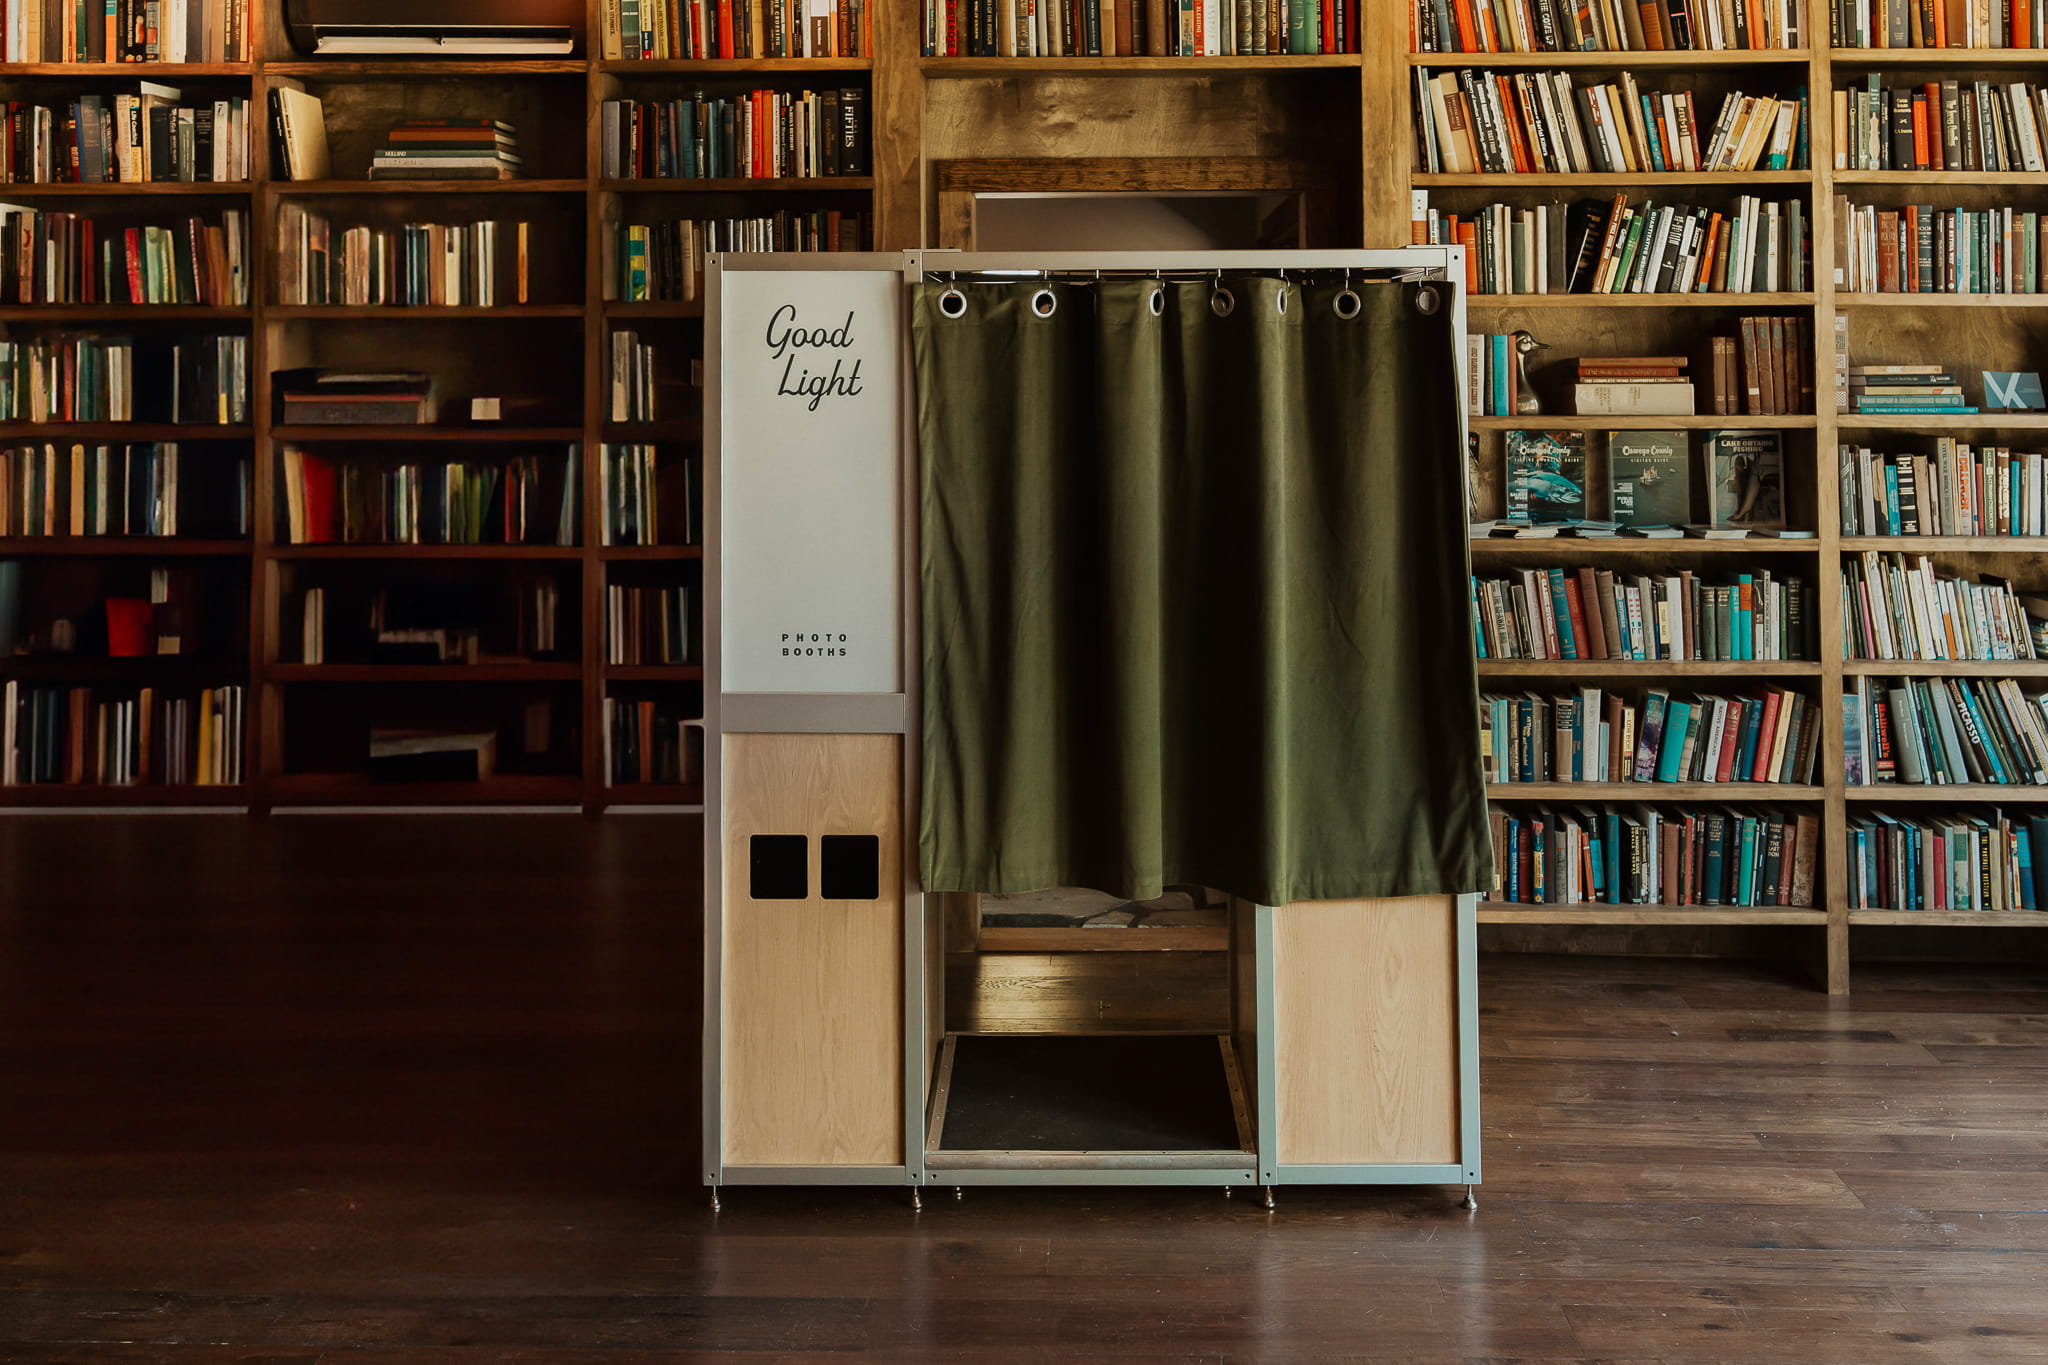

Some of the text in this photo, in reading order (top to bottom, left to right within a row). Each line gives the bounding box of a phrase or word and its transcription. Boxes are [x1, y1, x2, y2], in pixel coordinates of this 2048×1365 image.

[1539, 0, 1548, 12] THE
[1542, 13, 1551, 34] COME
[947, 26, 955, 49] ROSE
[1466, 77, 1474, 93] Century
[844, 106, 854, 147] FIFTIES
[1535, 119, 1544, 137] Serial
[1539, 137, 1548, 156] Killers
[1637, 211, 1656, 280] QUANTITATIVE MEDICIN
[766, 305, 854, 359] Good
[778, 354, 862, 411] Light
[1518, 444, 1571, 456] Oswego County
[1622, 445, 1672, 456] Oswego County
[1959, 457, 1968, 509] DILLINGER
[782, 633, 847, 642] PHOTO
[782, 648, 846, 656] BOOTHS
[1878, 703, 1890, 757] Halliwell's
[1957, 701, 1980, 744] PICASSO
[1711, 725, 1720, 756] AMERICANS
